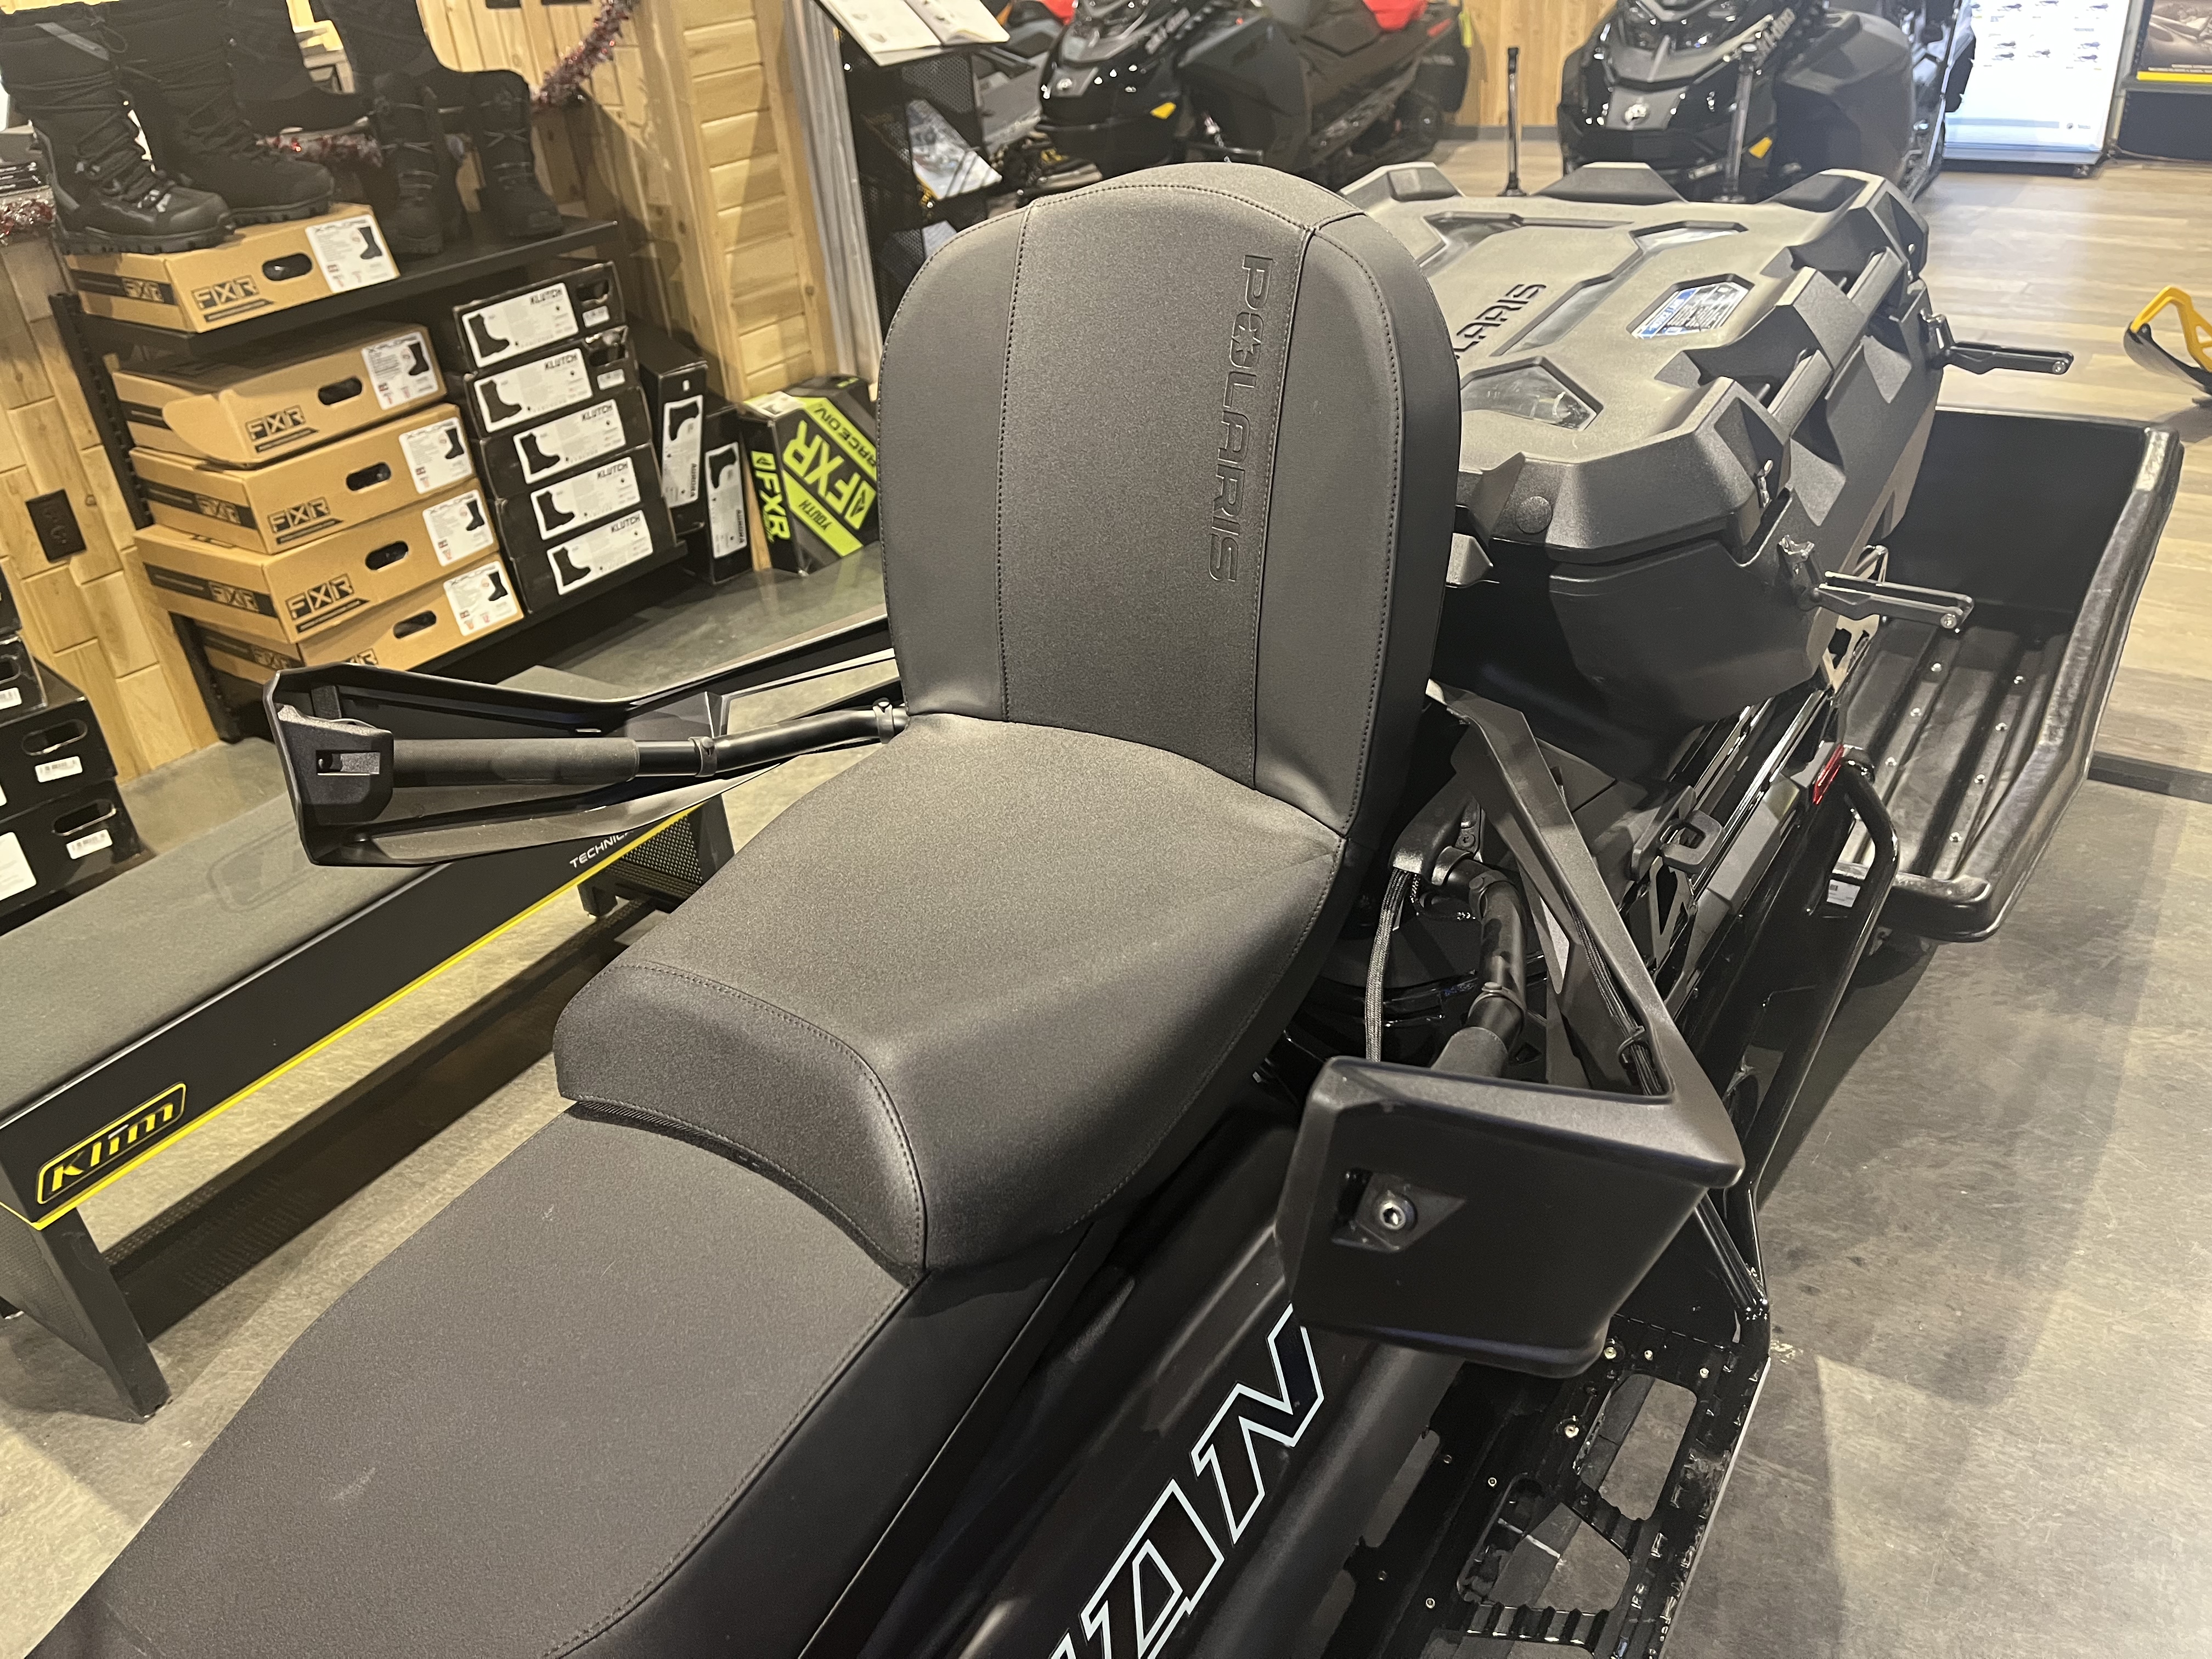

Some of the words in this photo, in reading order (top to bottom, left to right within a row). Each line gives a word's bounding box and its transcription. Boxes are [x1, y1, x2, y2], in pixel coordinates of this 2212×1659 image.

[192, 275, 259, 309] FXR
[529, 289, 563, 305] KLUTCH
[544, 354, 578, 371] KLUTCH
[245, 404, 306, 439] FXR
[582, 405, 613, 421] KLUTCH
[1208, 255, 1273, 582] POLARIS
[597, 463, 629, 479] KLUTCH
[782, 420, 861, 515] FXR
[267, 496, 331, 533] FXR
[754, 470, 792, 540] FXR
[798, 500, 833, 531] YOUTH
[611, 515, 641, 533] KLUTCH
[285, 573, 354, 619] FXR
[569, 831, 634, 868] TECHNIC
[1048, 1302, 1324, 1659] AN
